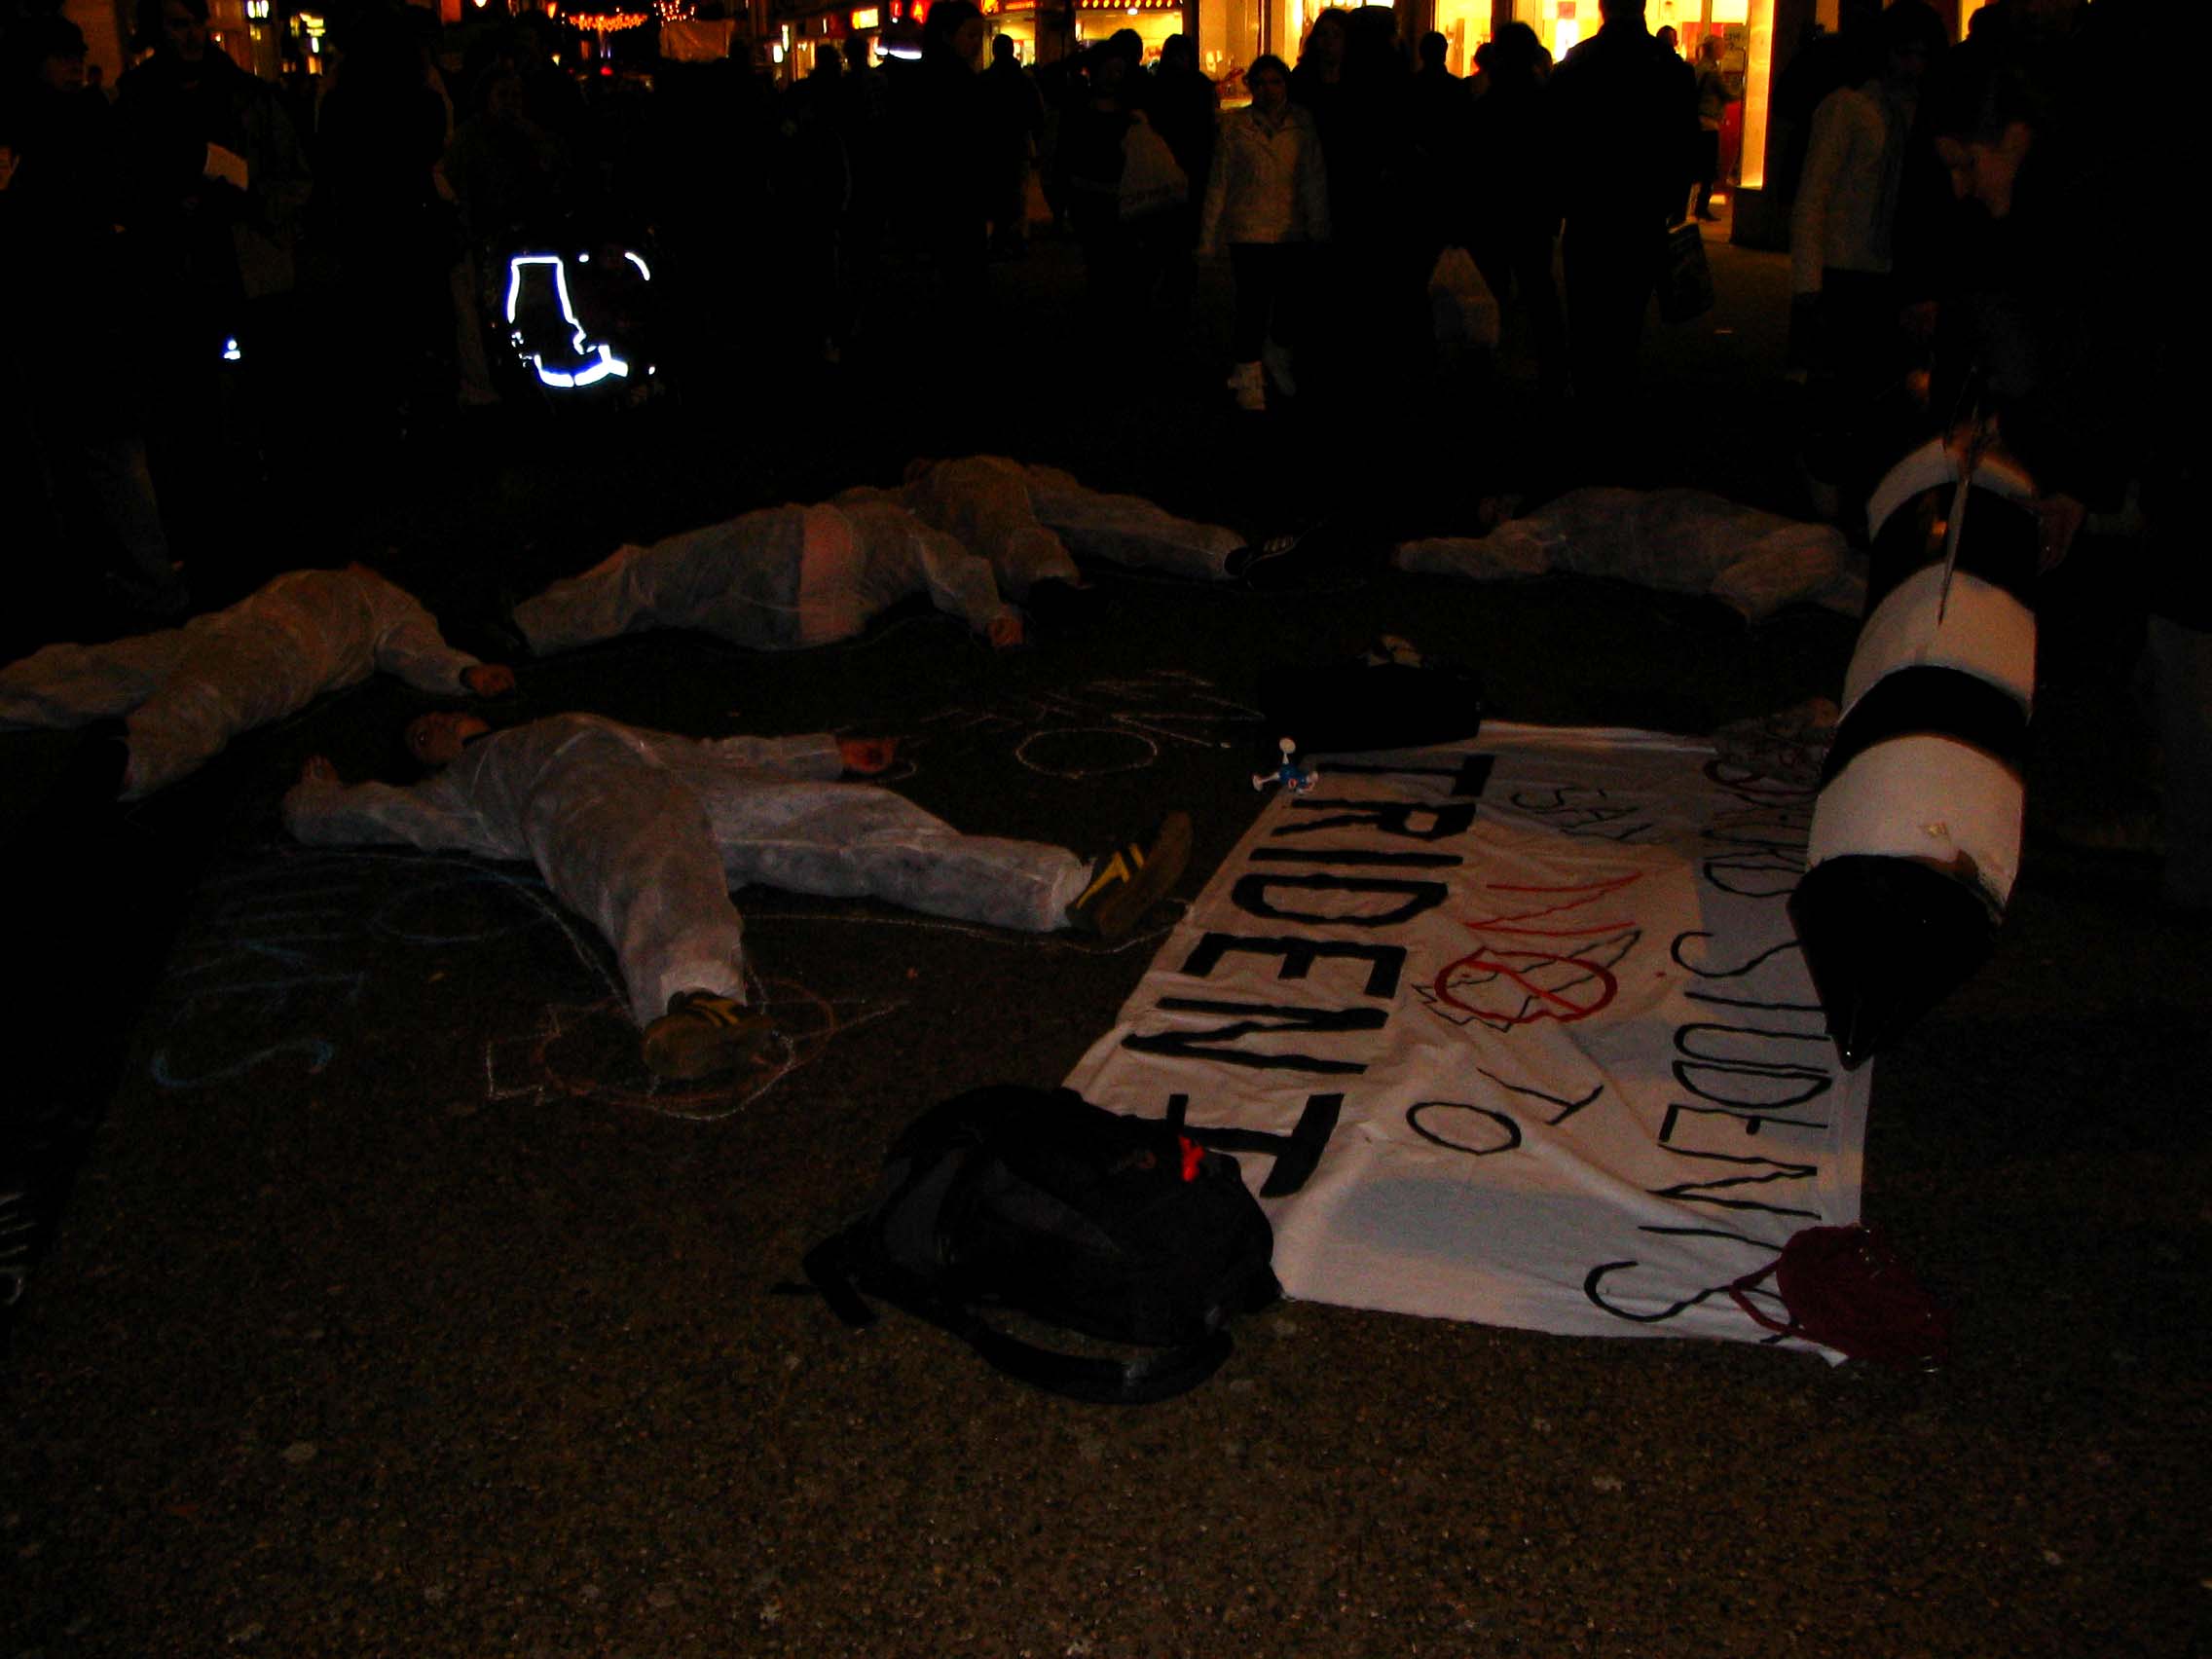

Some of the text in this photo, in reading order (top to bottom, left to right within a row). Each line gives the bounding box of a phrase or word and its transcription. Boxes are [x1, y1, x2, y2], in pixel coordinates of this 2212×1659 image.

[1123, 755, 1494, 1198] TRIDENT
[1407, 785, 1652, 1156] SAY NO TO
